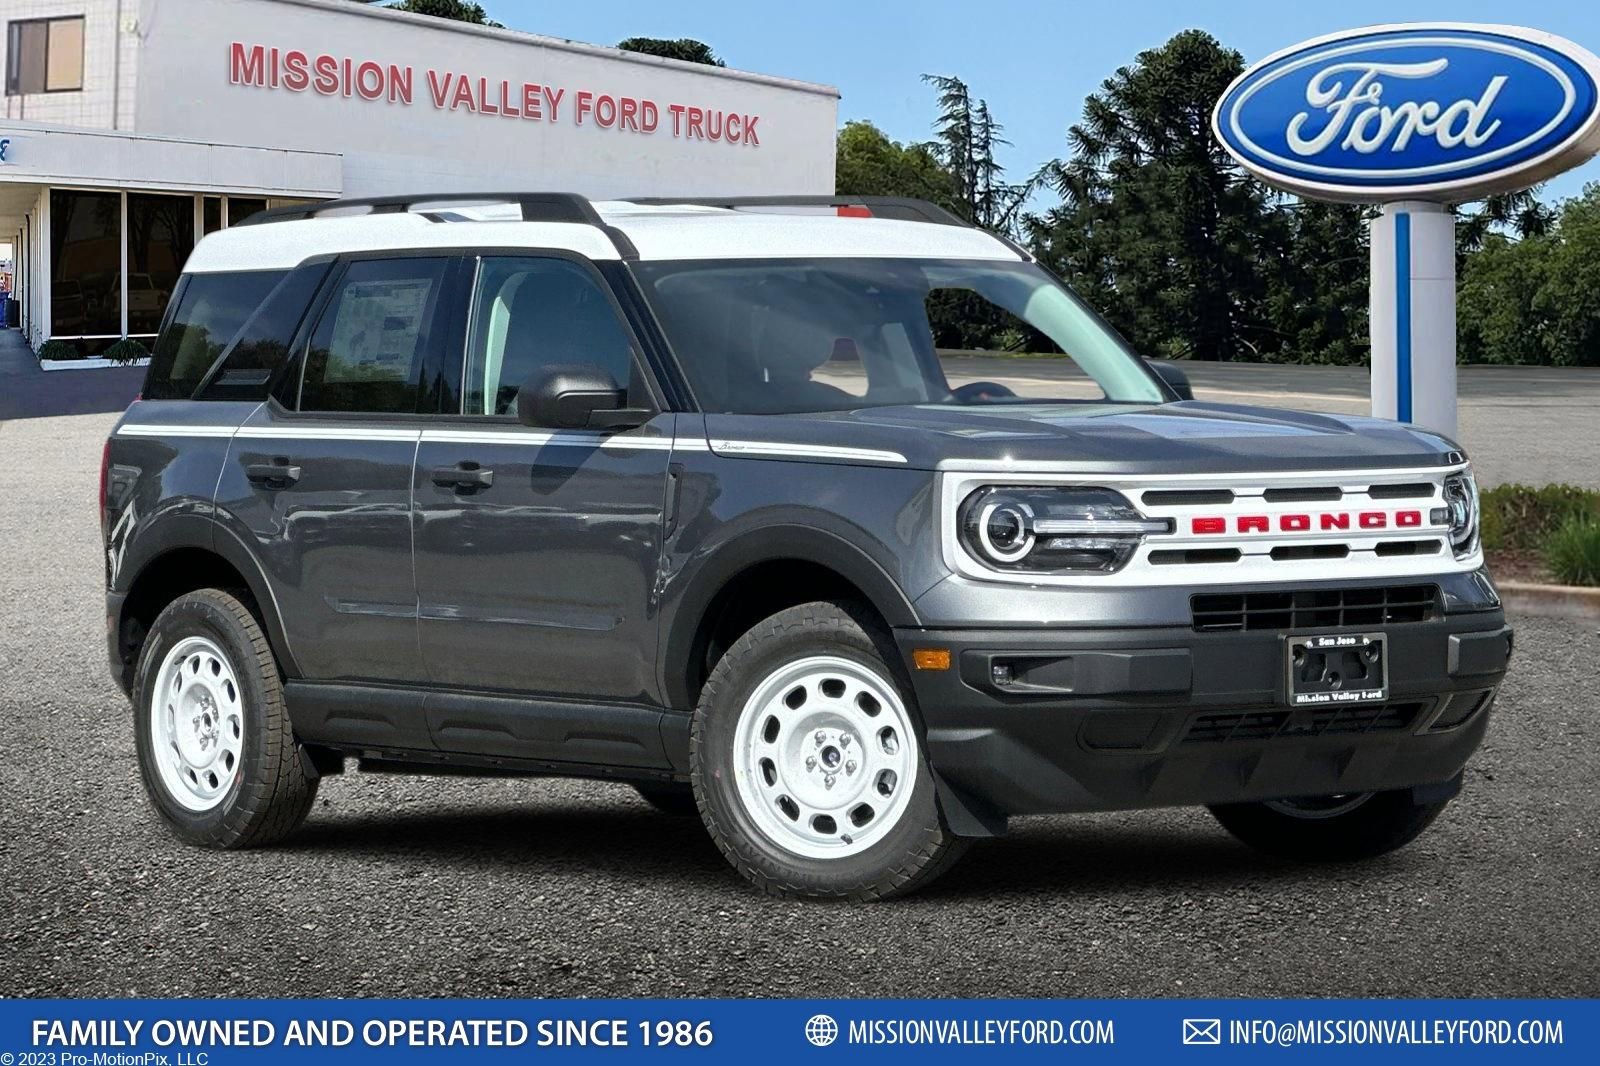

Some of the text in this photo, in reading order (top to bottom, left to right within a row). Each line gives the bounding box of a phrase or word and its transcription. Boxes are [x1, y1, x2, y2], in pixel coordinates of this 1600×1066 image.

[230, 41, 761, 147] MISSION VALLEY FORD TRUCK
[1287, 57, 1508, 156] Ford
[1191, 510, 1421, 535] BRONCO
[1318, 637, 1335, 646] San
